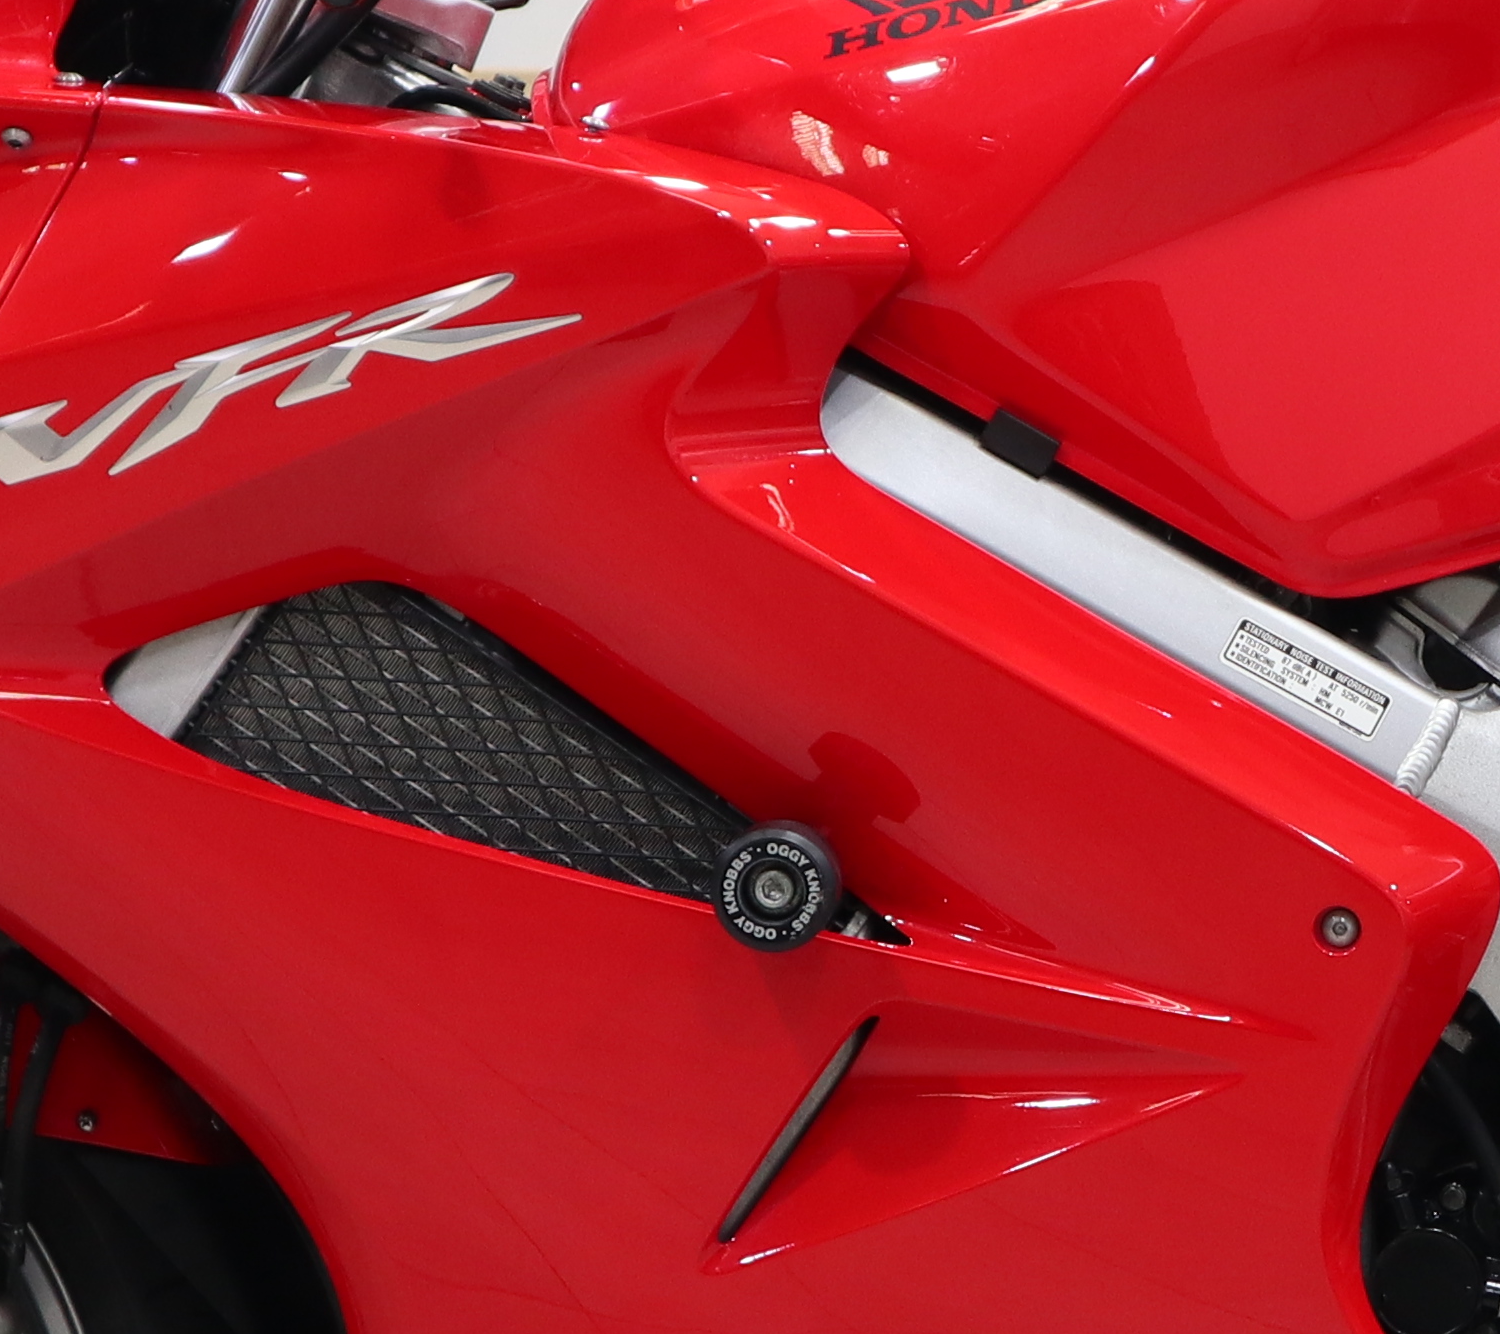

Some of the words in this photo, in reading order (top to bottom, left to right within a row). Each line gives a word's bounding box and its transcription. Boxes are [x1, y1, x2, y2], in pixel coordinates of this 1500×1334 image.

[1235, 651, 1287, 685] IDENTIFICATION
[1240, 643, 1276, 668] SILENCING
[1280, 664, 1309, 687] SYSTEM
[1243, 622, 1290, 652] STATIONARY
[1290, 644, 1314, 666] NOISE
[1315, 660, 1334, 678] TEST
[1335, 670, 1387, 705] INFORMATION
[1244, 634, 1271, 655] TESTED
[1328, 681, 1338, 693] AT
[766, 843, 810, 867] OGGY
[722, 850, 753, 915] KNOBBS
[734, 916, 777, 940] OGGY
